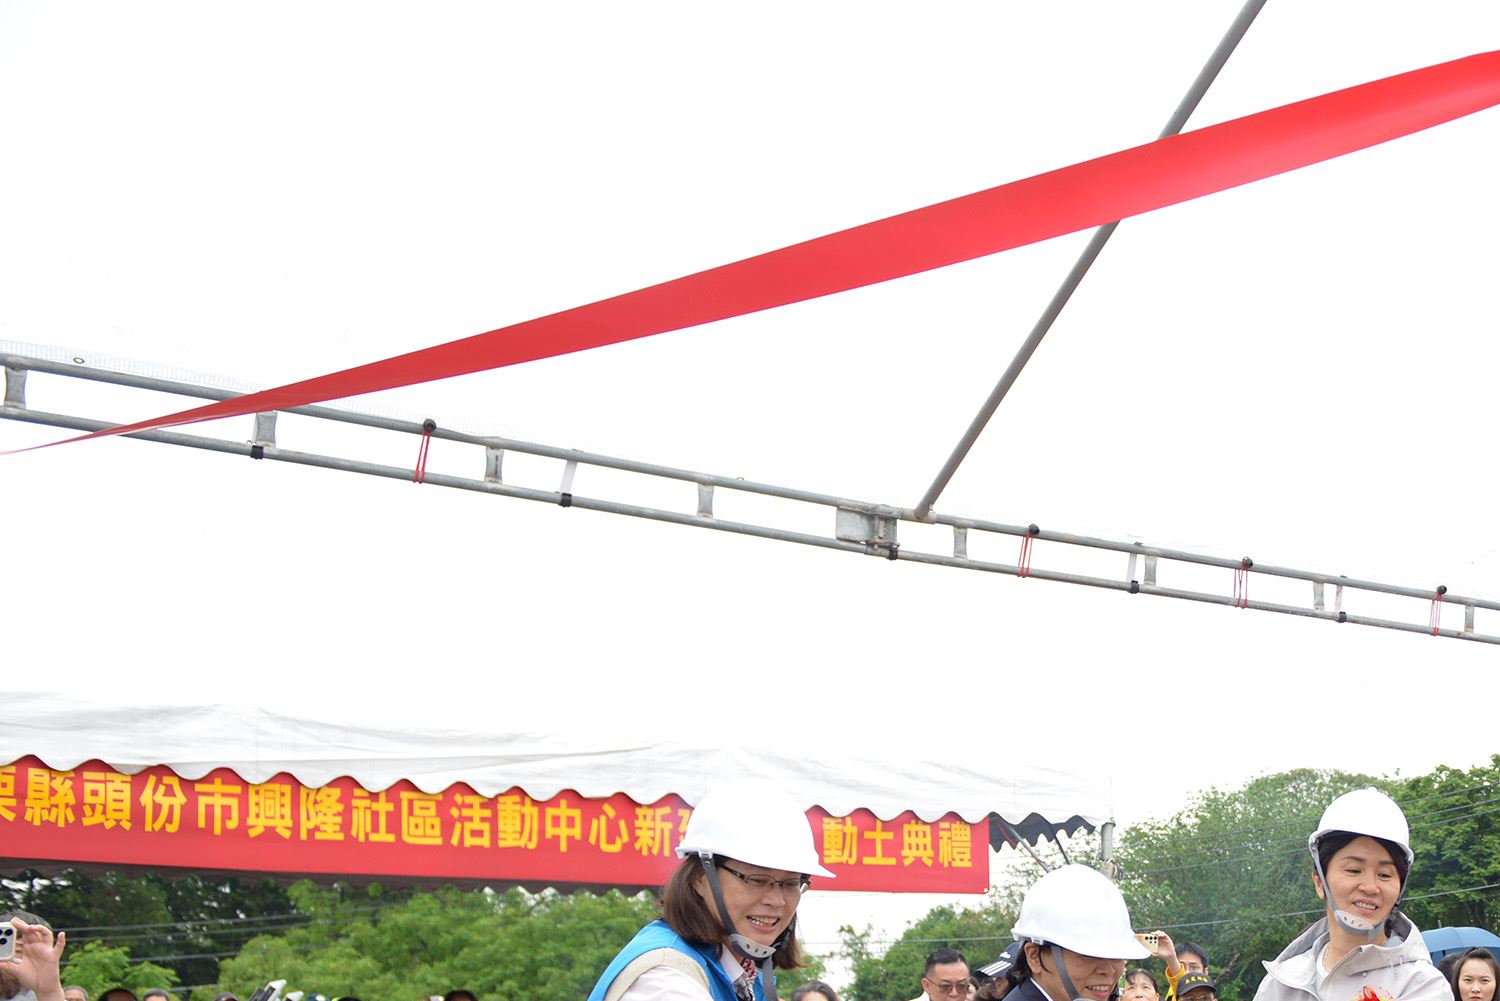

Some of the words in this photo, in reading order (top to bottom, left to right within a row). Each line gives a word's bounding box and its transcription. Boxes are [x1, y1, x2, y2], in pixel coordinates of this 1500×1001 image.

[0, 765, 694, 857] 縣頭份市興隆社區活動中心新
[822, 815, 974, 868] 動土典禮
